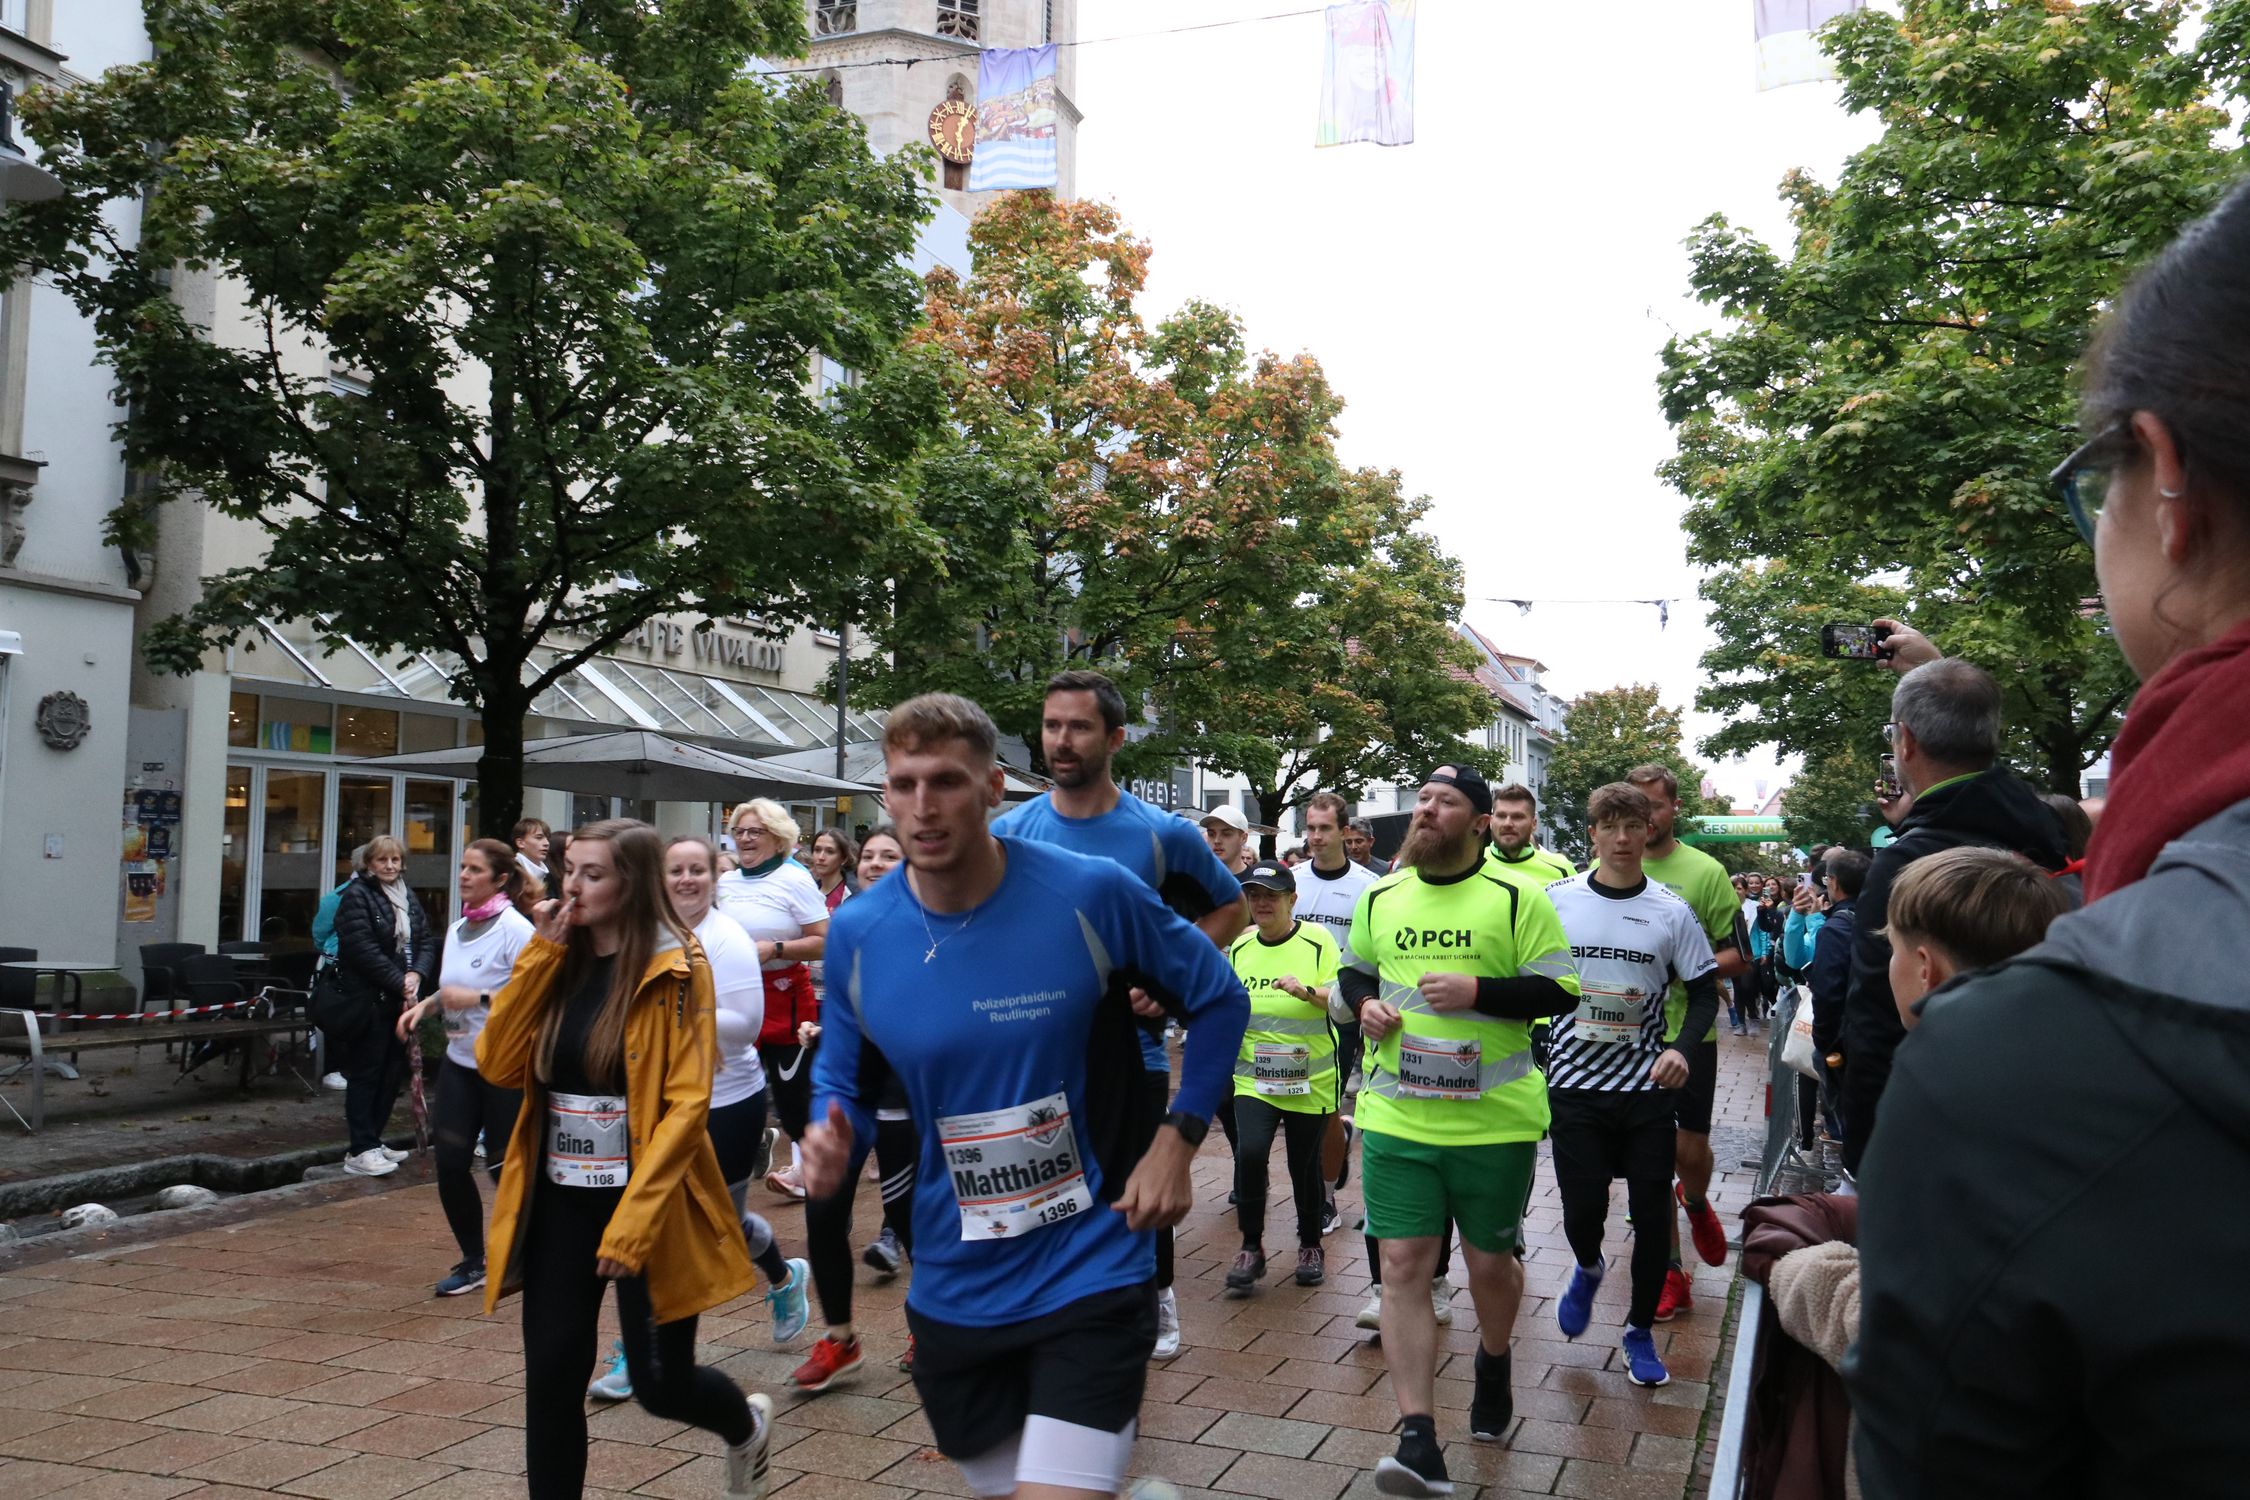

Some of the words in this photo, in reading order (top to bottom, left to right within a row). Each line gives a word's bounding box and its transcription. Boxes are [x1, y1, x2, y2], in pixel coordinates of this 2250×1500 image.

[693, 628, 786, 673] VIVALDI
[1422, 929, 1471, 948] PCH
[990, 1006, 1051, 1023] Reutlingen
[1590, 1005, 1625, 1022] Timo
[1402, 1052, 1422, 1064] 1331
[1255, 1066, 1306, 1078] Christiane
[1400, 1068, 1476, 1089] Marc-Andre
[557, 1132, 594, 1155] Gina
[948, 1147, 983, 1165] 1396
[585, 1174, 615, 1185] 1108
[953, 1151, 1073, 1198] Matthias
[1038, 1198, 1078, 1224] 1396
